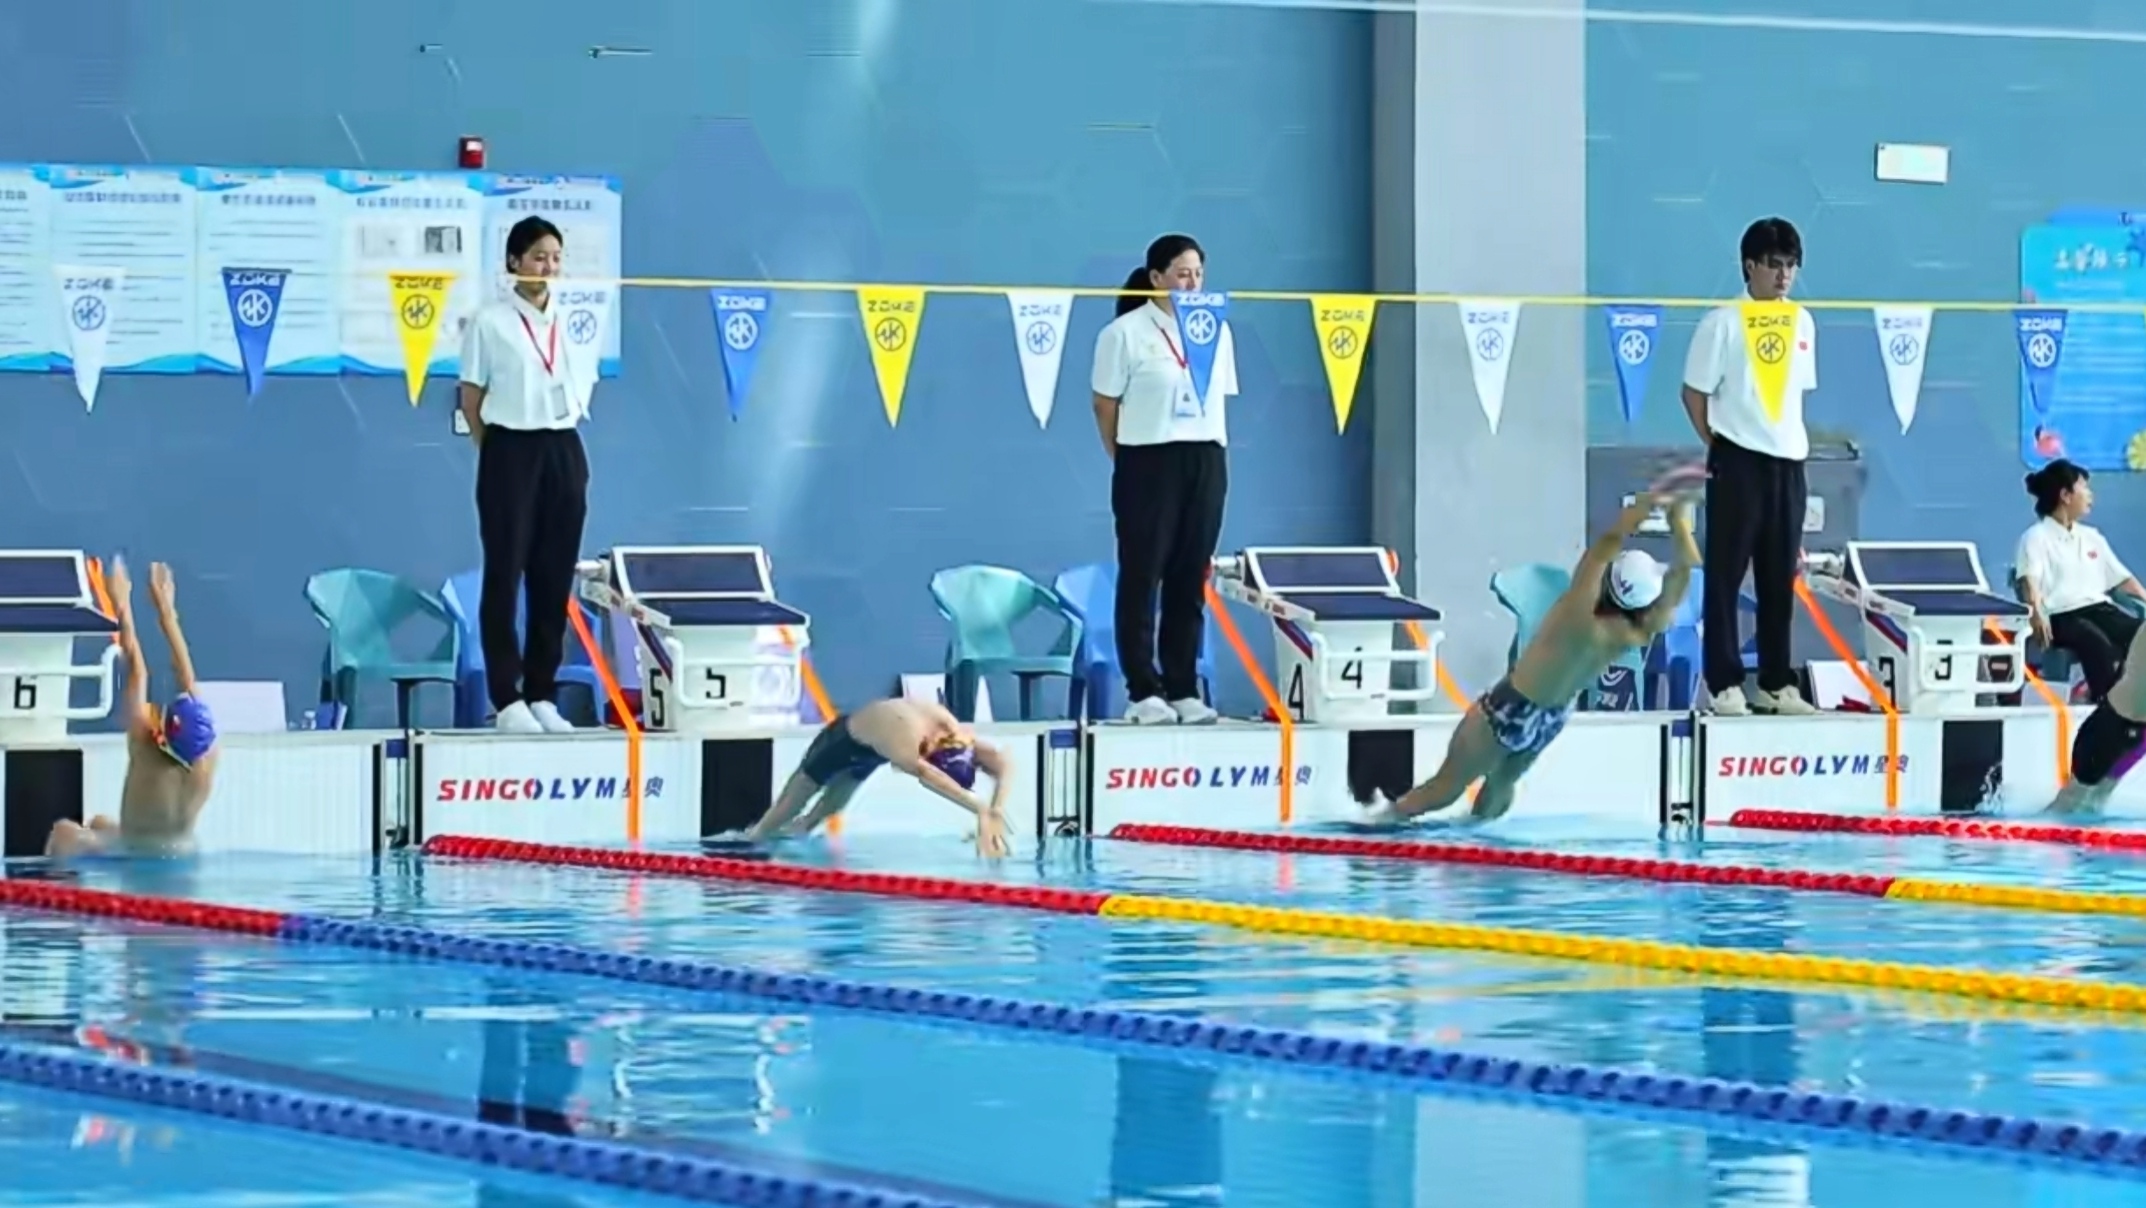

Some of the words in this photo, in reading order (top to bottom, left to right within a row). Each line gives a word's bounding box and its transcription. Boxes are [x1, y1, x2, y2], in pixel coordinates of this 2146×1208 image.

[230, 272, 281, 285] ZOKE
[1341, 646, 1363, 689] 4
[1935, 639, 1953, 680] 3
[14, 676, 37, 710] 6
[649, 668, 665, 727] 5
[706, 667, 726, 699] 5
[1288, 663, 1304, 719] 4
[1106, 765, 1270, 790] SINGOLYM
[1719, 755, 1869, 777] SINGOLYM
[437, 777, 616, 801] SINGOLYM
